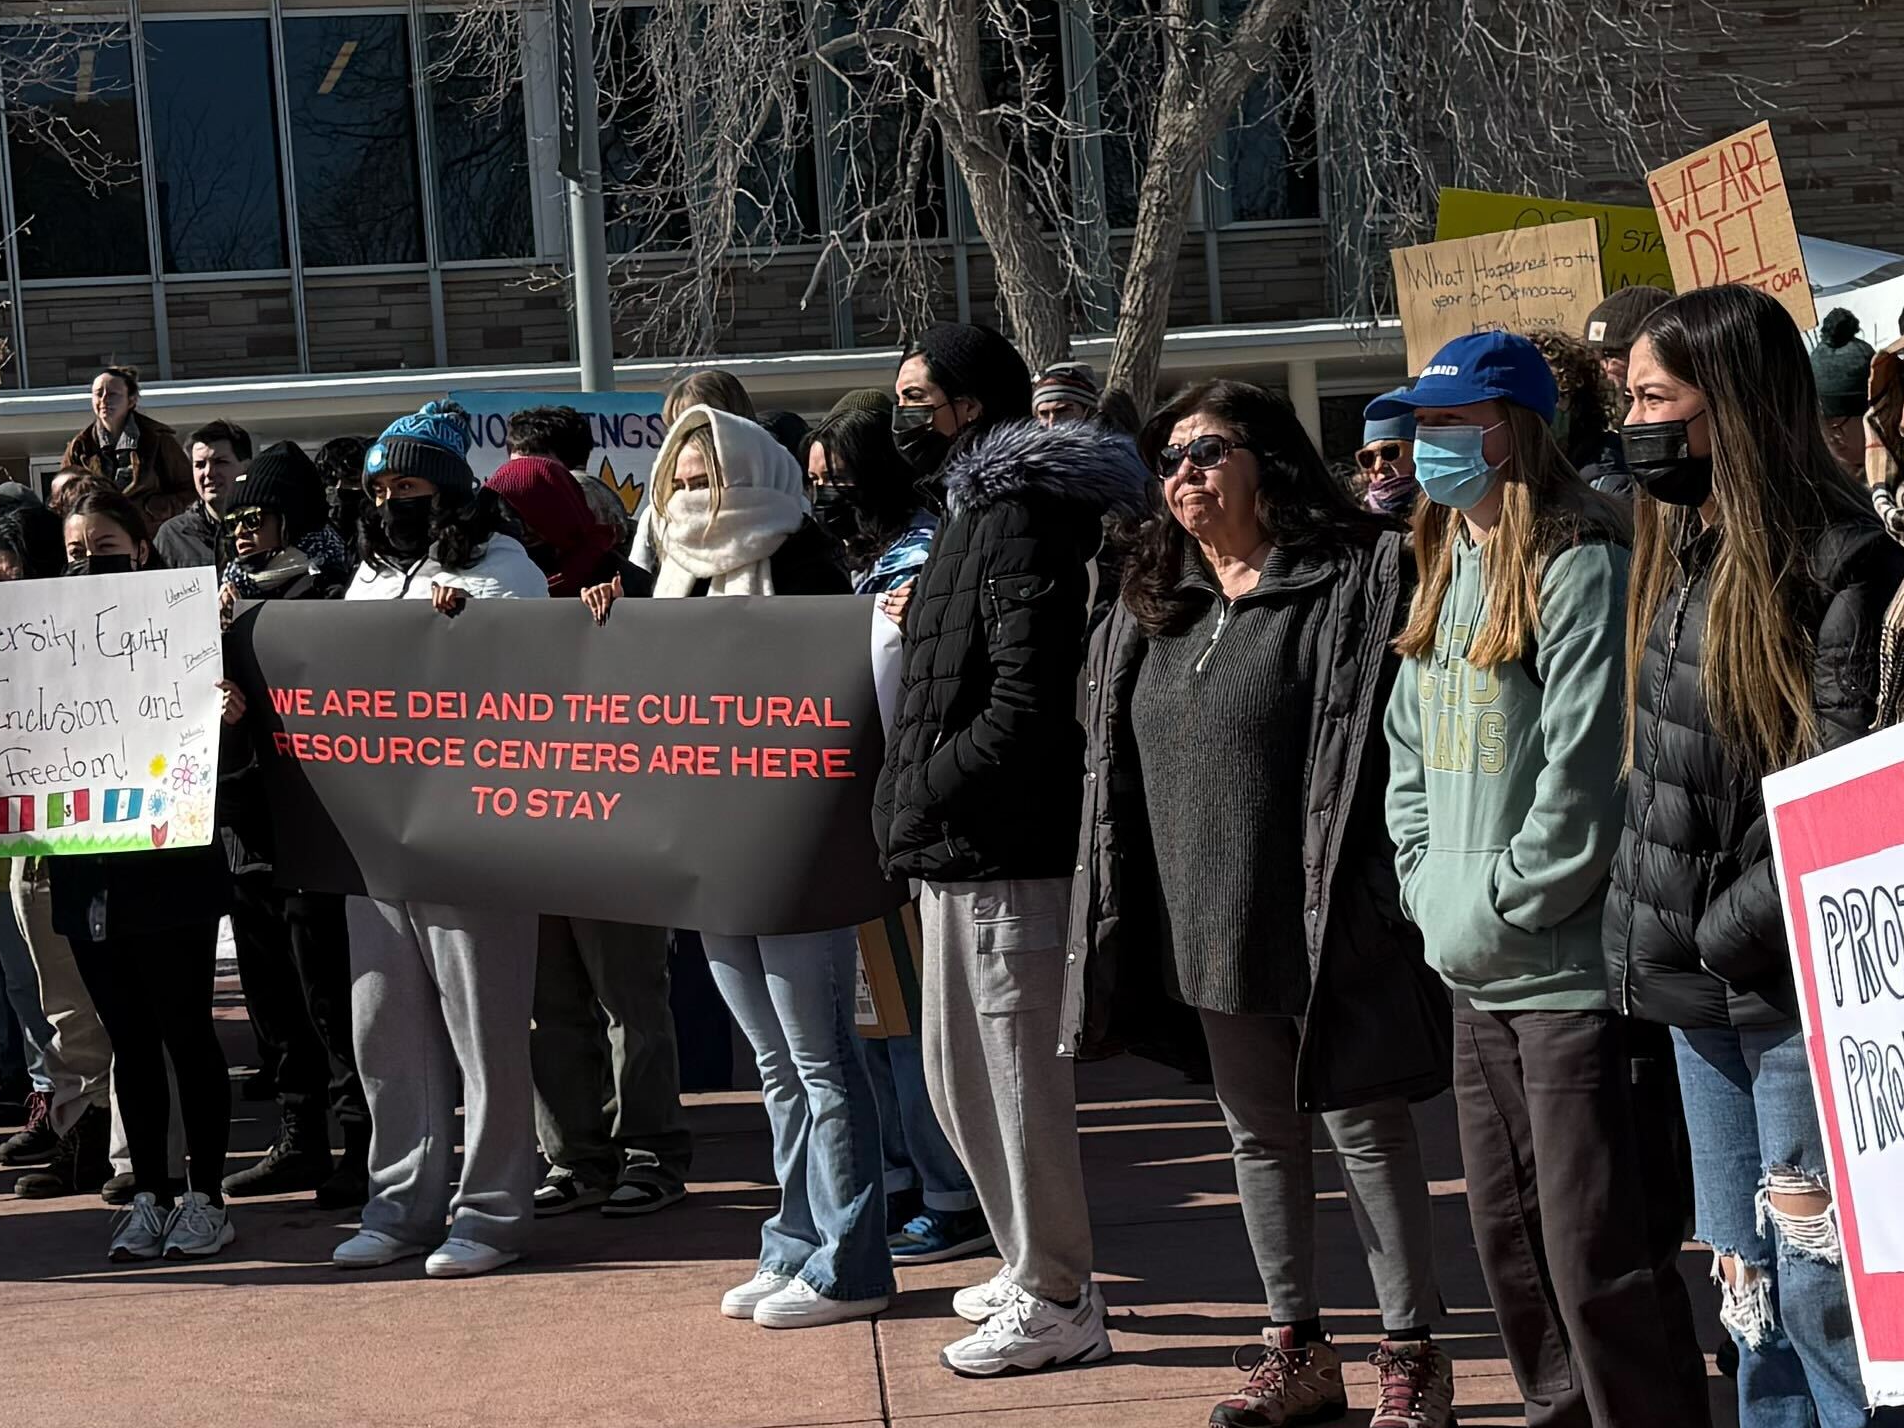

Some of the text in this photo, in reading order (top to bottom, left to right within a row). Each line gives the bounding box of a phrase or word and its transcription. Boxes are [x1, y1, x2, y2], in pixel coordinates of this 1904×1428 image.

[1652, 155, 1720, 232] WE
[1719, 128, 1782, 212] ARE
[1621, 229, 1667, 253] STA
[1685, 199, 1777, 290] DEI
[1403, 250, 1465, 290] What
[1553, 252, 1574, 269] to
[1772, 267, 1802, 293] OUR
[1431, 294, 1463, 315] year
[1470, 285, 1494, 308] of
[586, 413, 665, 449] INGS
[96, 605, 169, 671] Equity
[138, 682, 184, 720] and
[268, 688, 851, 728] WE ARE DEI AND THE CULTURAL
[272, 732, 856, 779] RESOURCE CENTERS ARE HERE
[471, 785, 622, 821] TO STAY
